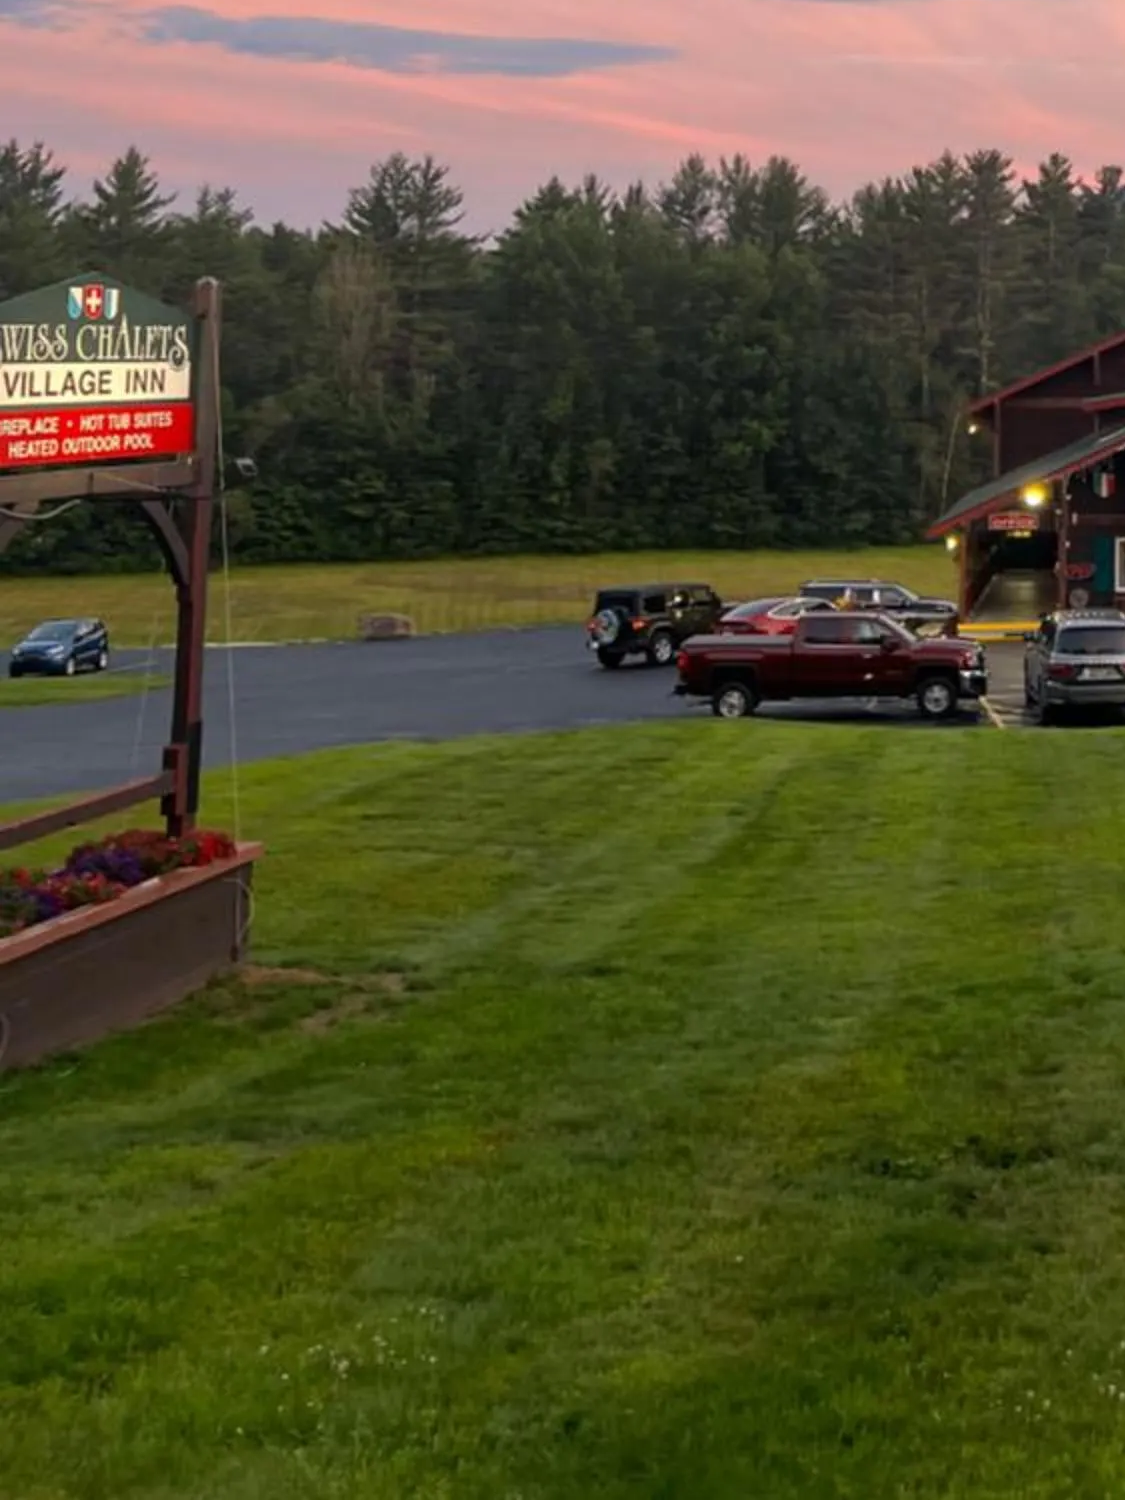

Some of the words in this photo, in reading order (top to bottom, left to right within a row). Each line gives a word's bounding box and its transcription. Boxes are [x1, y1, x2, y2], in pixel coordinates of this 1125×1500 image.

[0, 323, 68, 361] WISS
[76, 313, 189, 371] CHALETS
[3, 369, 113, 398] VILLAGE
[125, 368, 166, 394] INN
[0, 416, 60, 436] REPLACE
[80, 413, 104, 433] HOT
[108, 412, 130, 430] TUB
[133, 410, 173, 429] SUITES
[8, 438, 59, 459] HEATED
[62, 434, 120, 456] OUTDOOR
[124, 433, 155, 450] POOL
